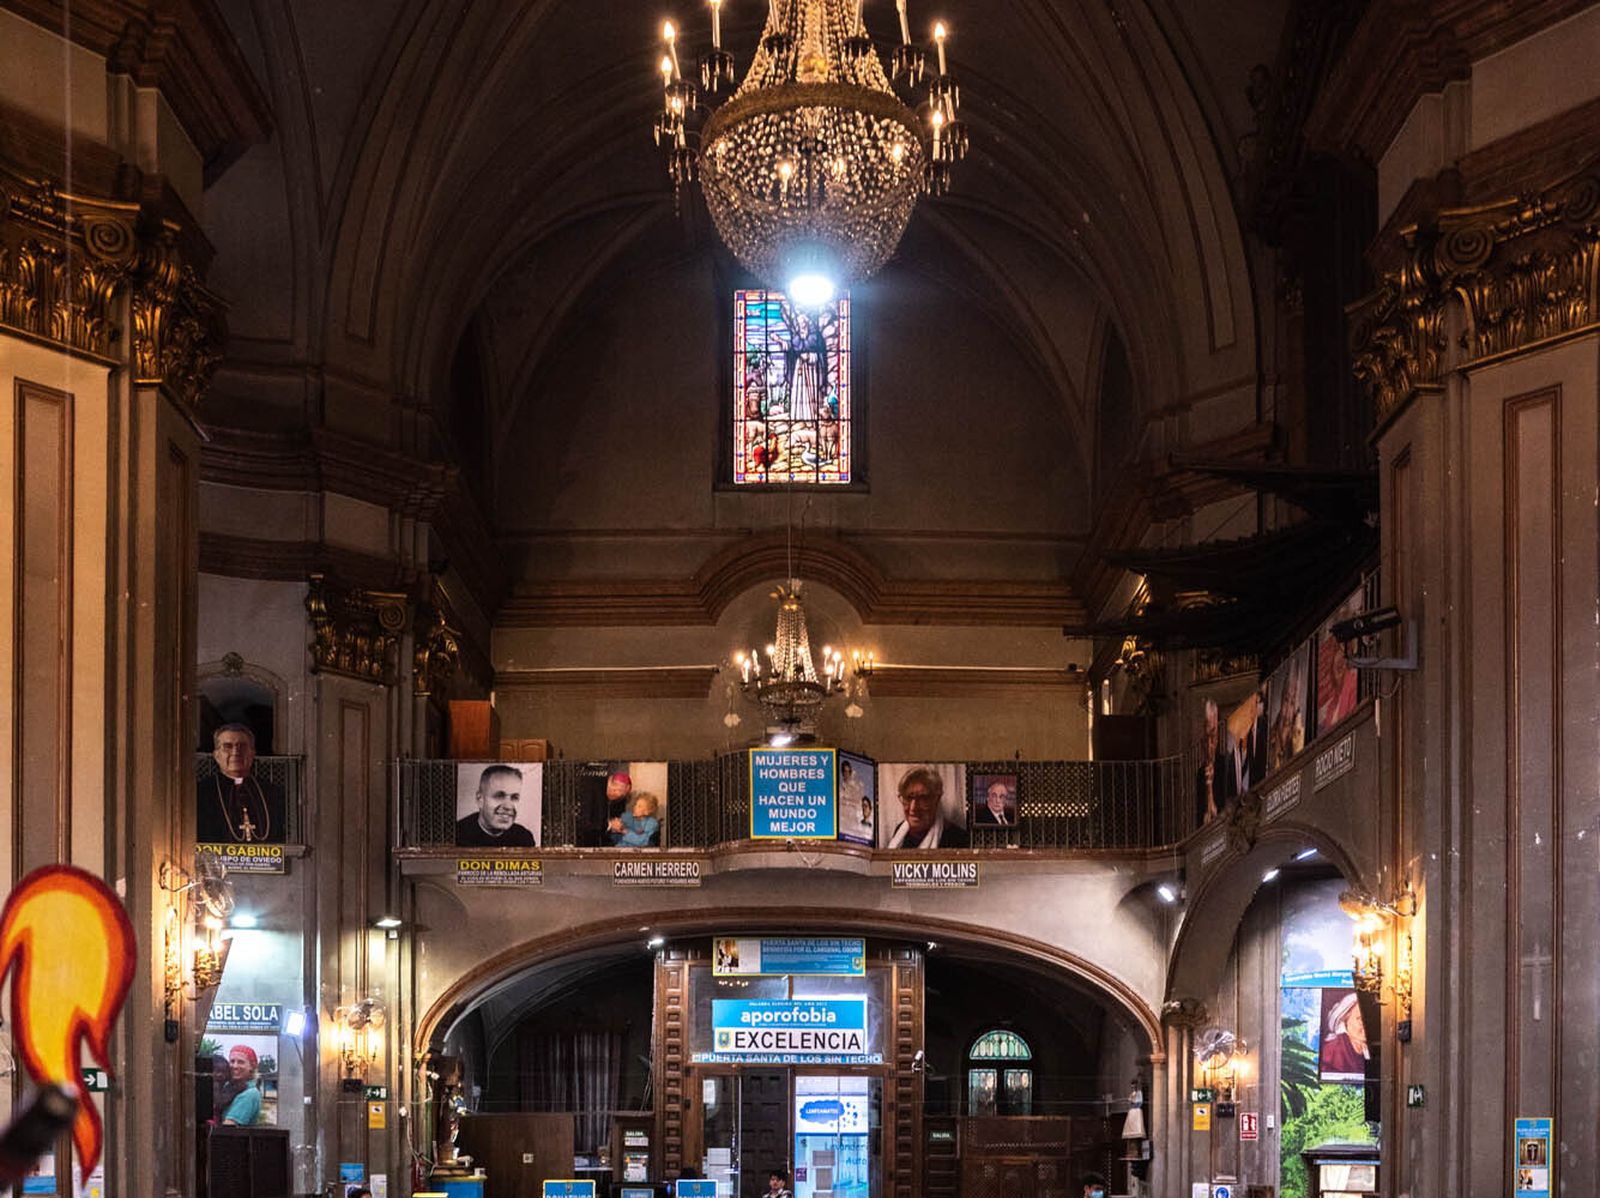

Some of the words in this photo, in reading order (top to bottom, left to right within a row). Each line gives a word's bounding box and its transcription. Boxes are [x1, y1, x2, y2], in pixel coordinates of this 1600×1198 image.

[755, 755, 818, 766] MUJERES
[821, 755, 829, 766] Y
[759, 769, 825, 779] HOMBRES
[778, 782, 806, 793] QUE
[759, 795, 804, 806] HACEN
[808, 795, 826, 806] UN
[768, 808, 817, 819] MUNDO
[770, 822, 816, 832] MEJOR
[226, 845, 281, 857] GABINO
[460, 861, 491, 871] DON
[495, 861, 540, 871] DIMAS
[614, 862, 653, 877] CARMEN
[655, 862, 700, 877] HERRERO
[894, 863, 929, 878] VICKY
[932, 863, 977, 878] MOLINS
[243, 1005, 279, 1021] SOLA
[740, 1006, 837, 1026] aporofobia
[735, 1031, 861, 1050] EXCELENCIA
[702, 1053, 744, 1063] PUERTA
[746, 1053, 781, 1063] SANTA
[783, 1053, 798, 1063] DE
[801, 1053, 821, 1063] LOS
[844, 1053, 882, 1064] TECHO
